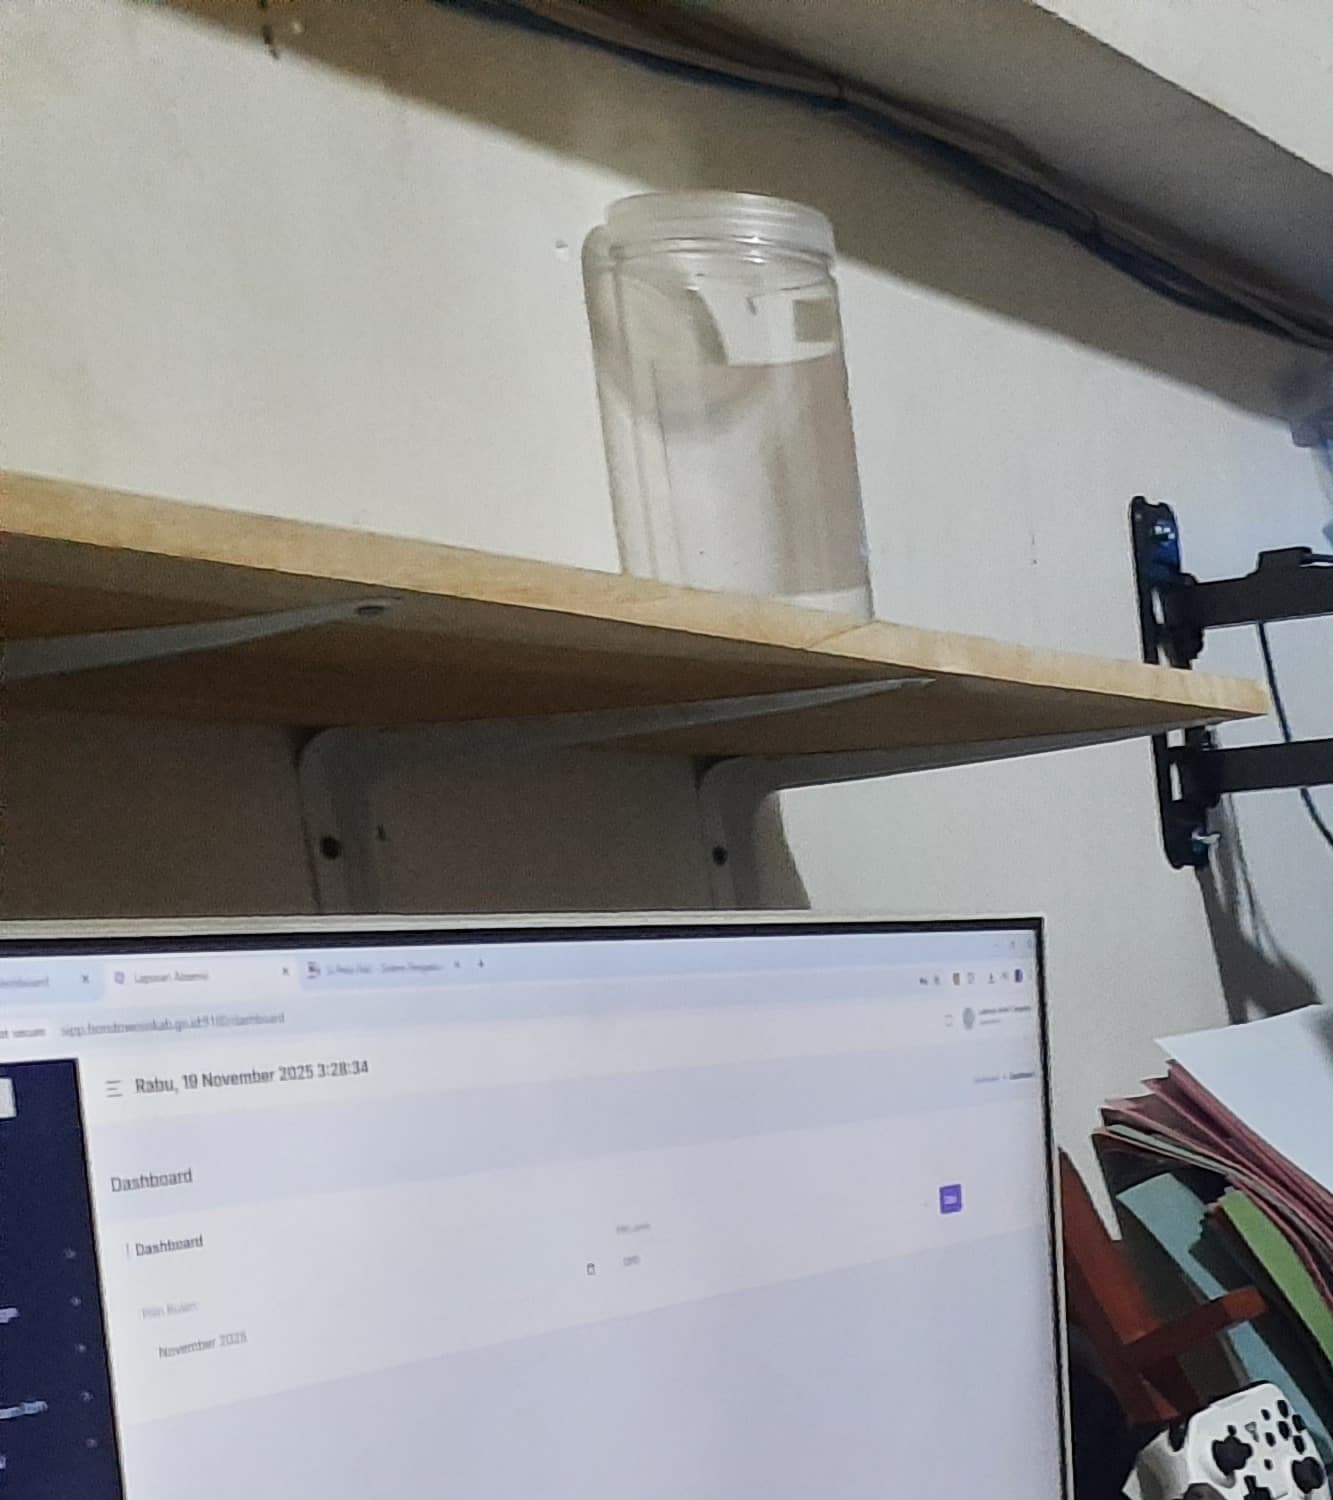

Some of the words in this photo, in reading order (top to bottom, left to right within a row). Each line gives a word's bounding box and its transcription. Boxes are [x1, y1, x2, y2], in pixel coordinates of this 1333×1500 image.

[135, 1077, 179, 1095] Rabu,
[182, 1074, 199, 1090] 19
[202, 1068, 276, 1089] November
[279, 1065, 314, 1082] 2025
[110, 1167, 193, 1193] Dashboard
[135, 1233, 204, 1257] Dashboard
[158, 1337, 217, 1359] November
